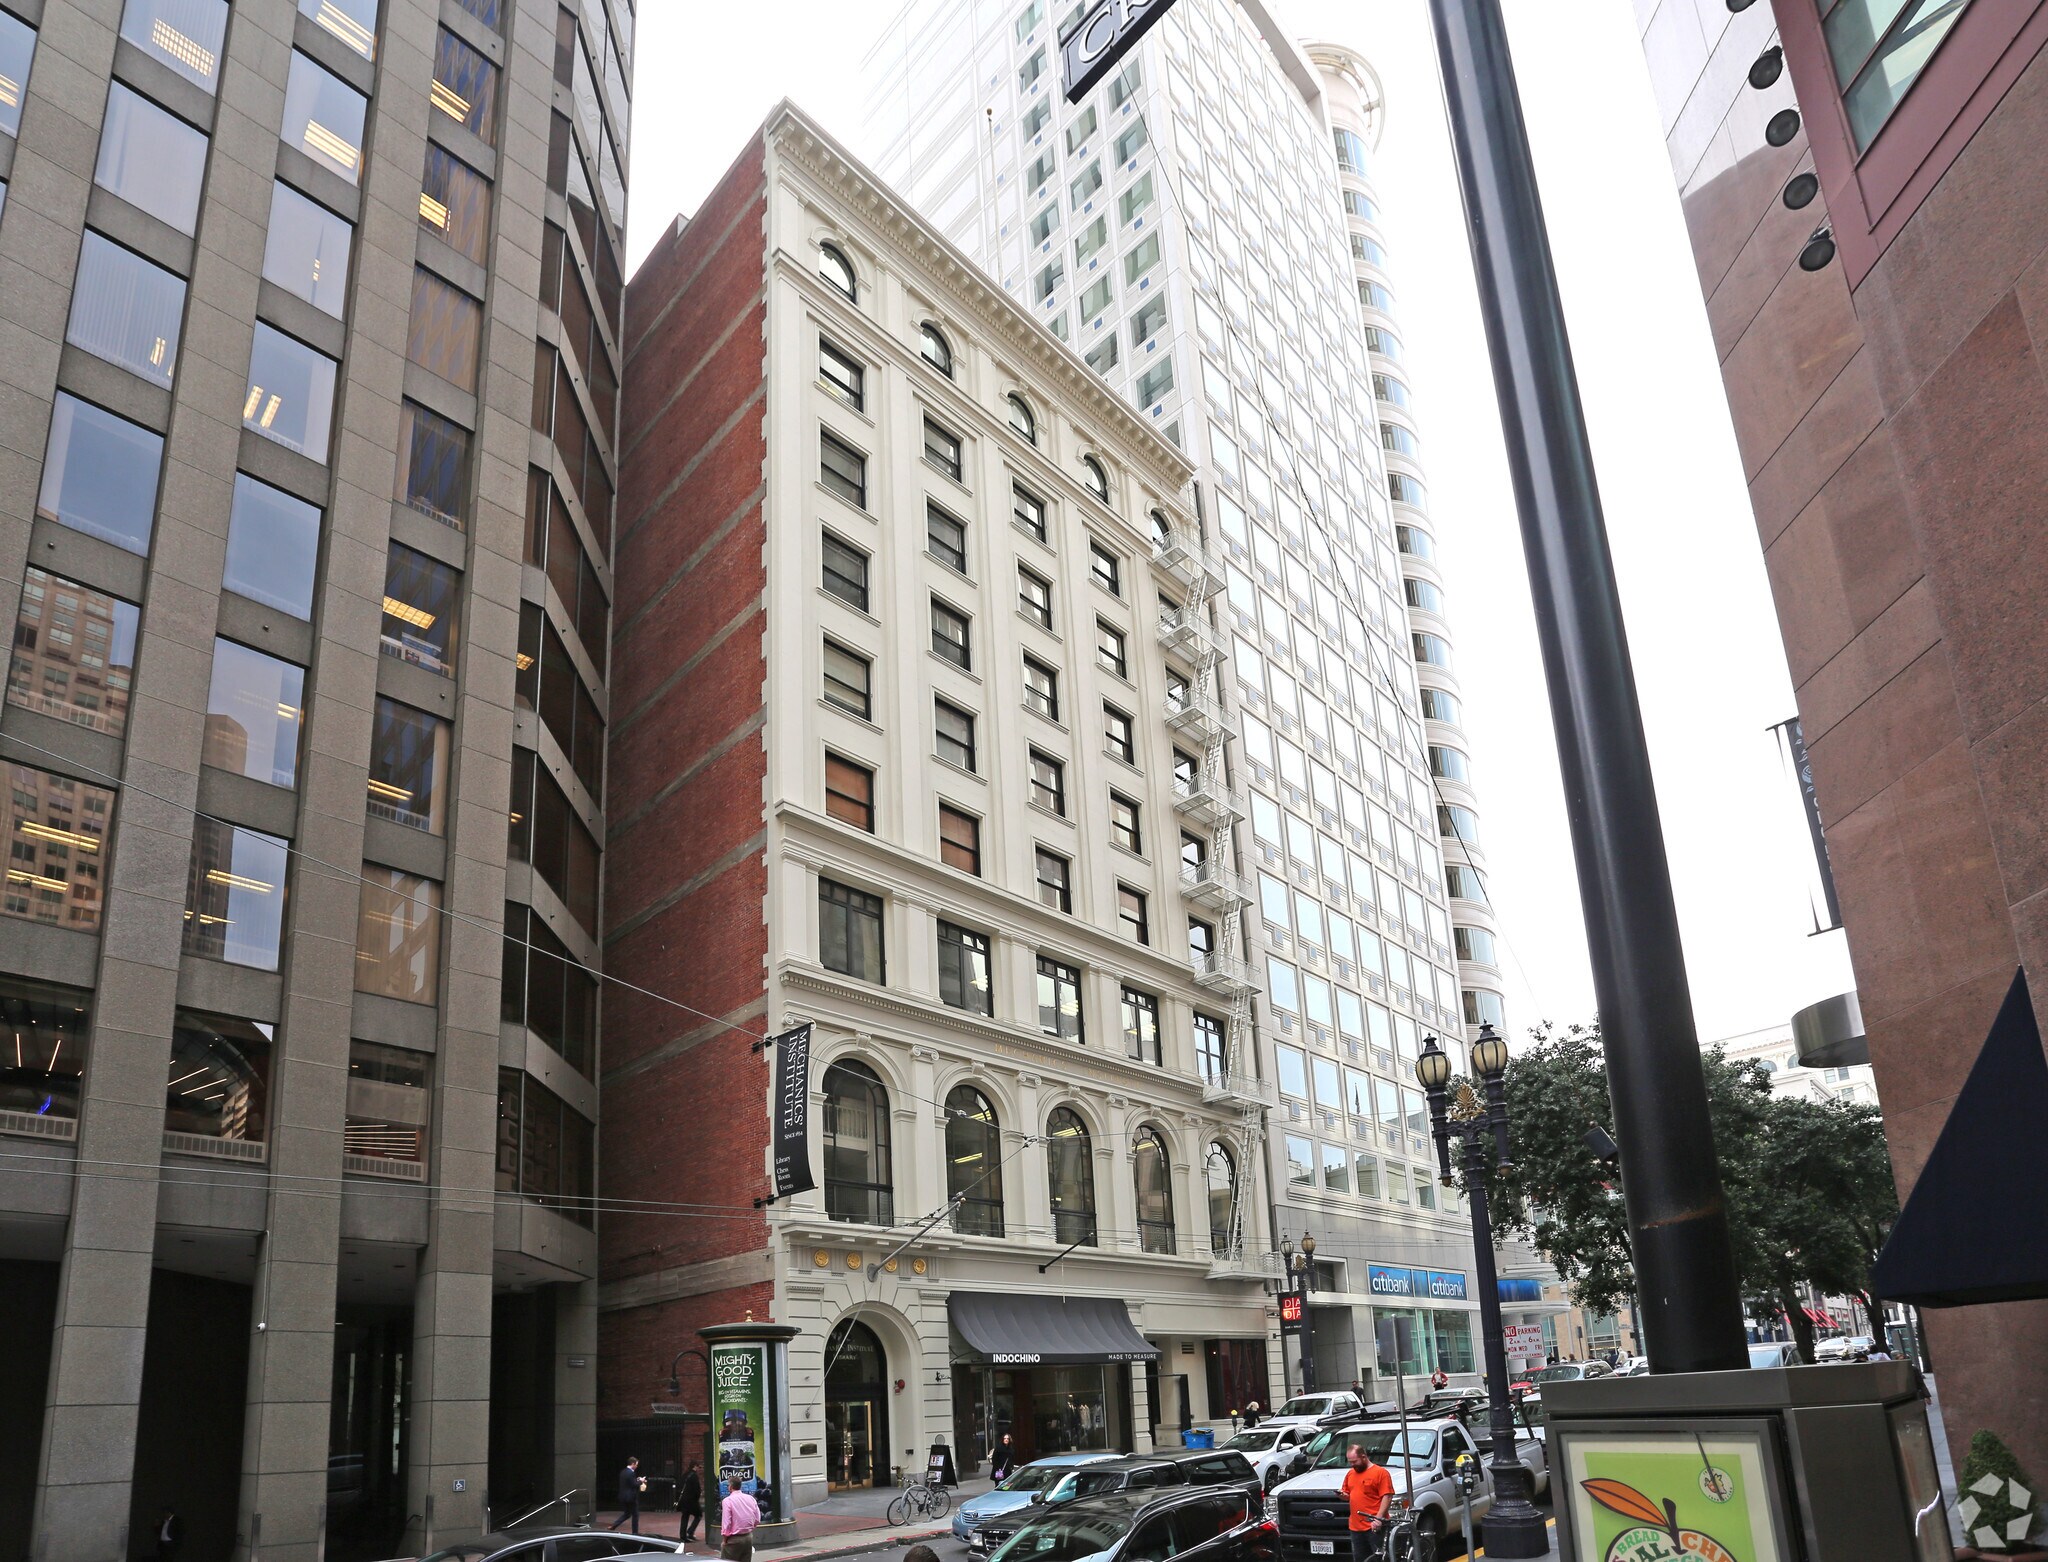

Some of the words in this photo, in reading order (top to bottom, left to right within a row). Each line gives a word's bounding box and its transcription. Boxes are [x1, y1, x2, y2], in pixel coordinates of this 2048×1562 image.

[784, 1035, 798, 1129] INSTITUTE
[776, 1156, 791, 1164] Library
[778, 1173, 791, 1181] Room
[780, 1183, 794, 1191] Events
[1372, 1273, 1410, 1293] citibank
[1432, 1278, 1464, 1297] citibank
[1505, 1327, 1516, 1336] NO
[1518, 1327, 1540, 1335] PARKING
[715, 1354, 756, 1366] MIGHTY.
[993, 1354, 1040, 1363] INDOCHINO
[716, 1366, 754, 1376] GOOD.
[718, 1377, 751, 1387] JUICE.
[1616, 1531, 1660, 1555] BREAD
